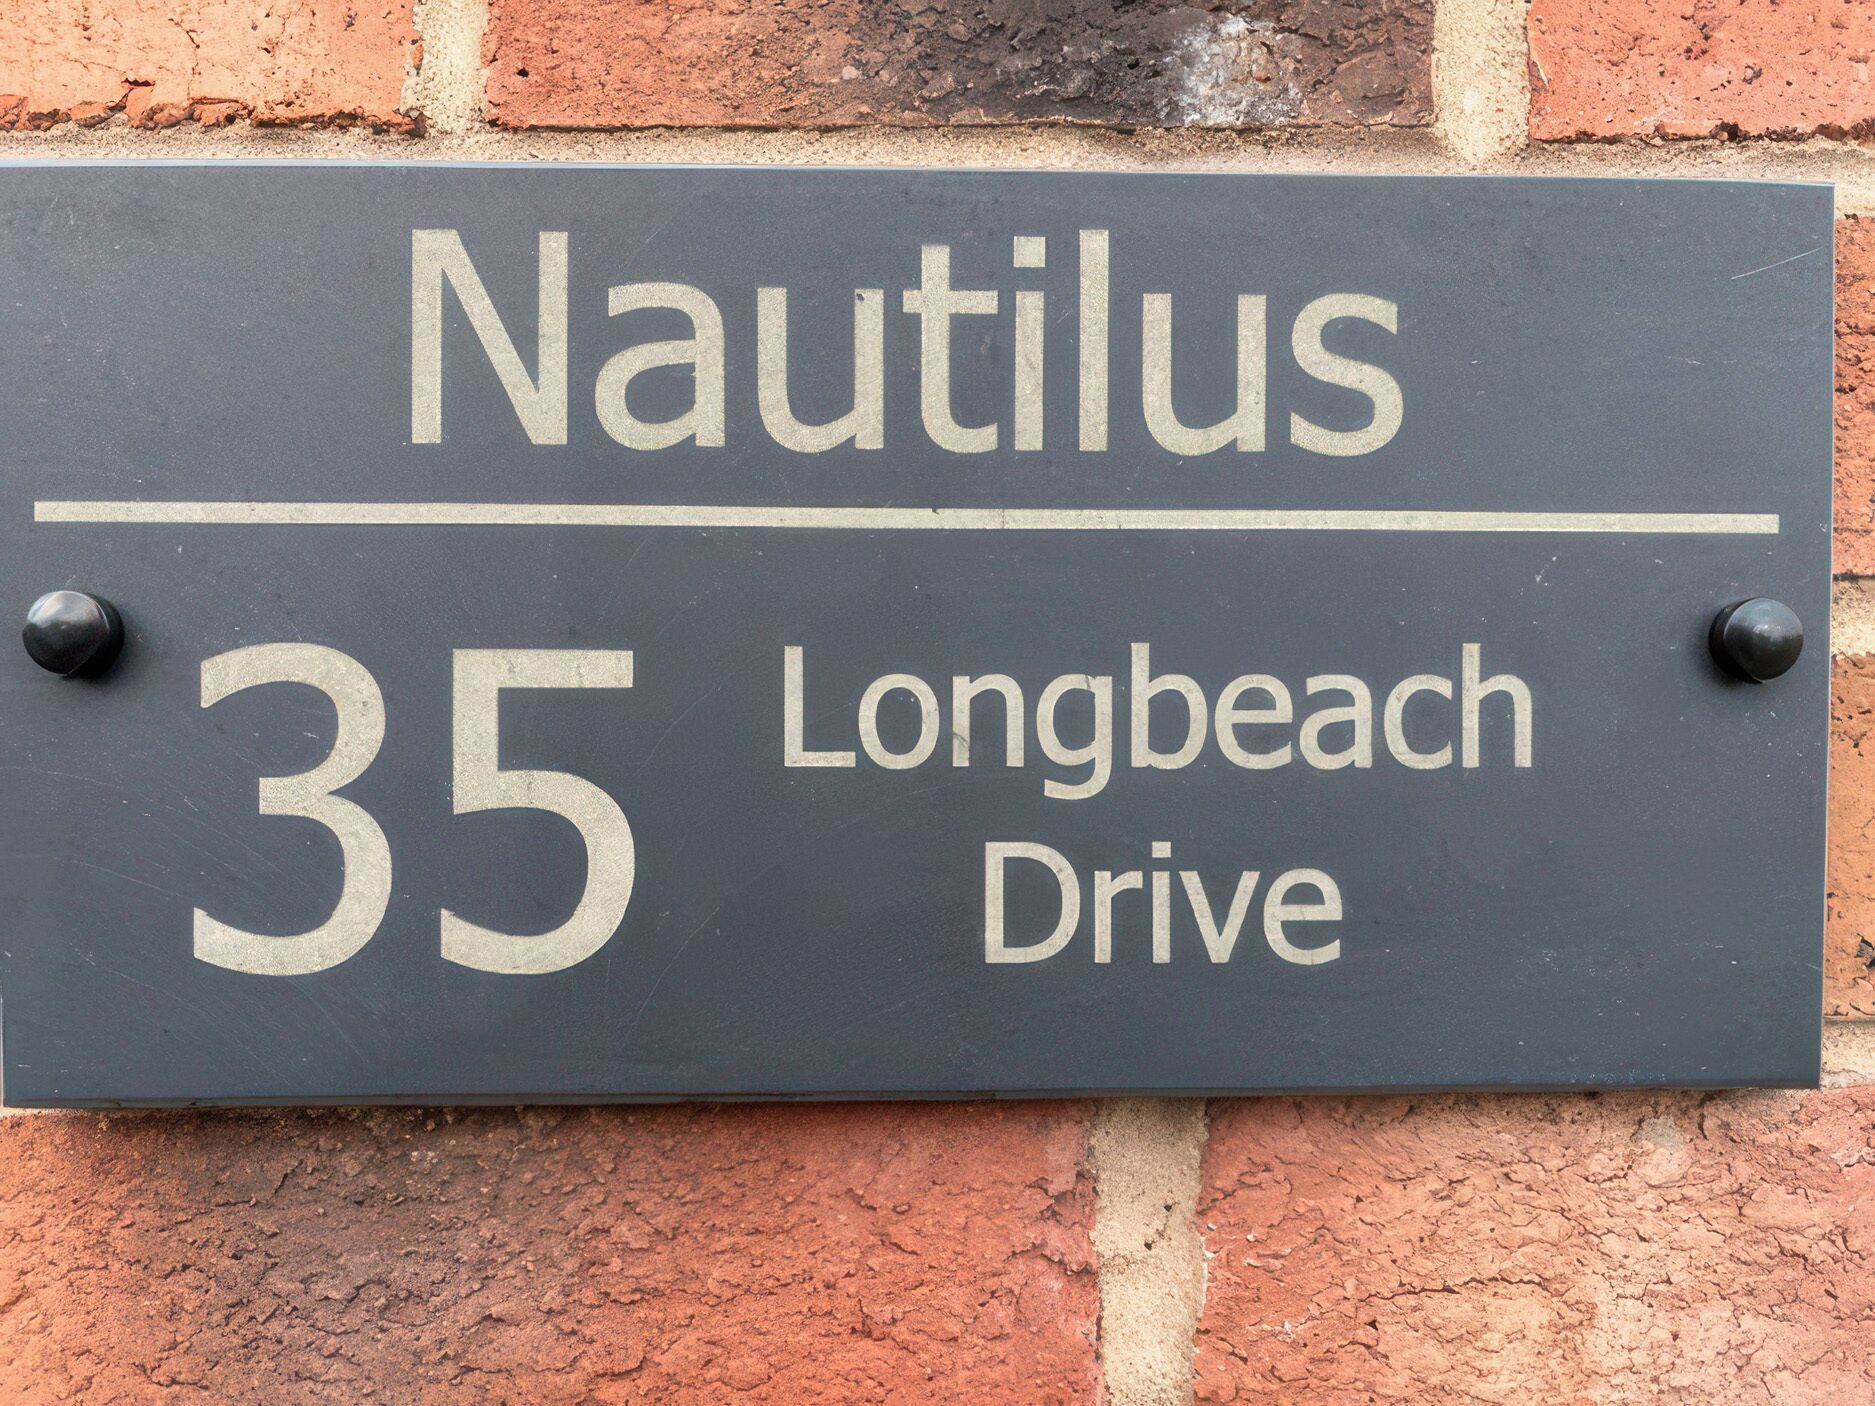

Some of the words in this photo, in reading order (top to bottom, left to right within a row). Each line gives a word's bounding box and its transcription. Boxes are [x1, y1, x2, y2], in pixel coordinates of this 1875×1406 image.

[410, 228, 1404, 457] Nautilus
[192, 641, 636, 977] 35
[783, 642, 1533, 801] Longbeach
[984, 841, 1344, 966] Drive
